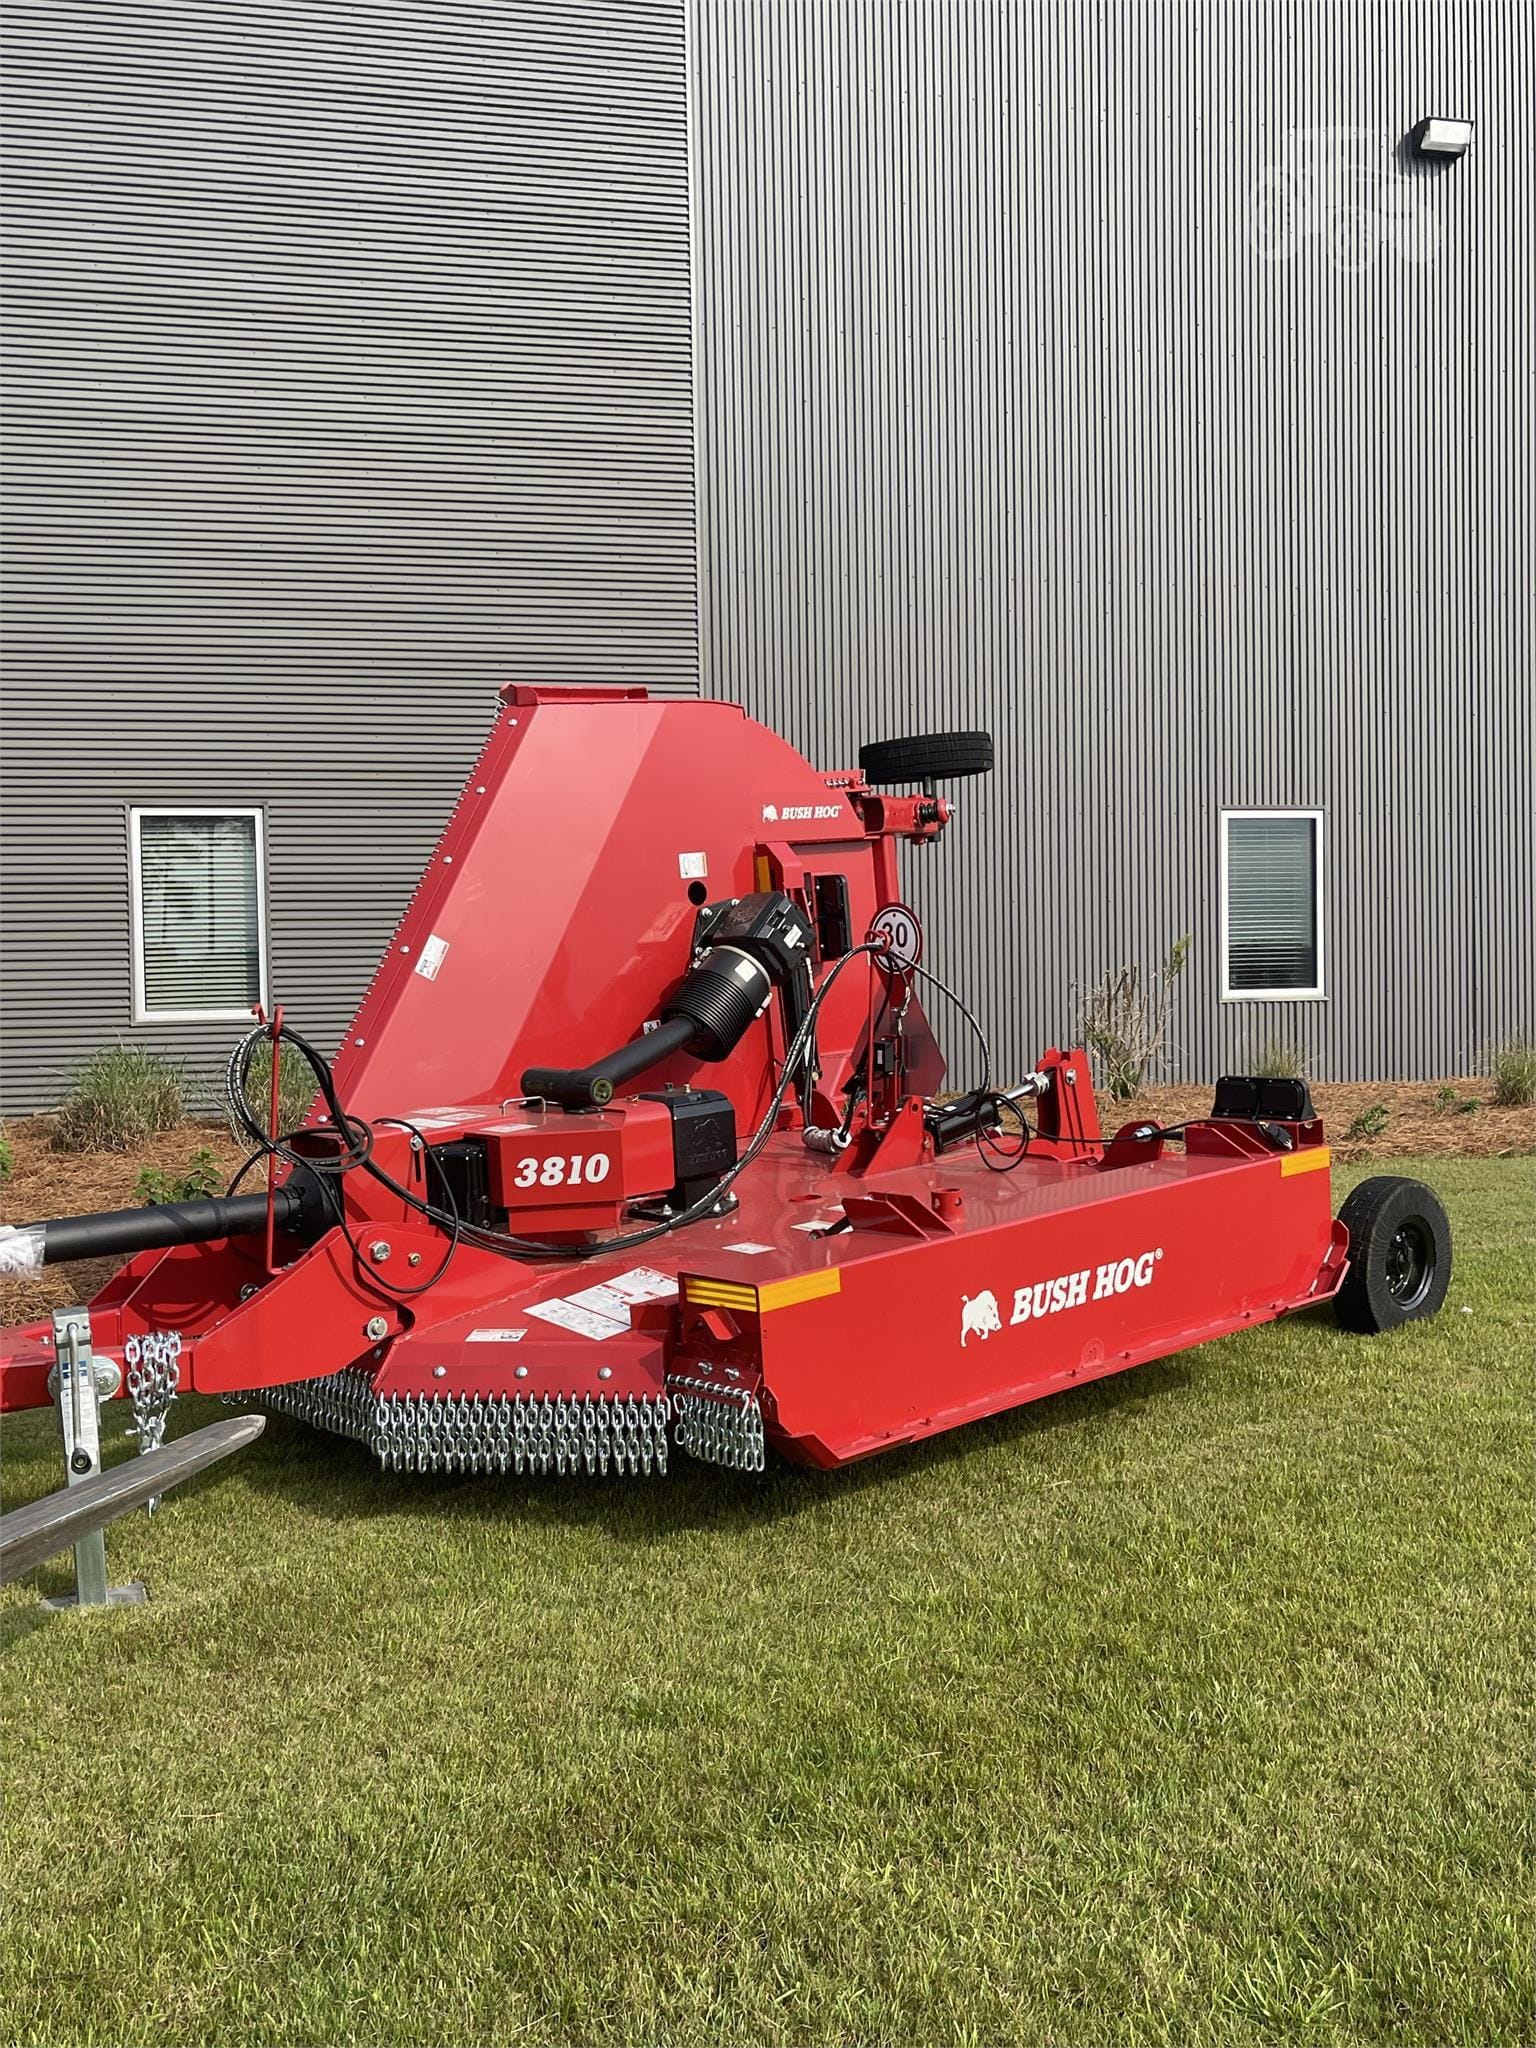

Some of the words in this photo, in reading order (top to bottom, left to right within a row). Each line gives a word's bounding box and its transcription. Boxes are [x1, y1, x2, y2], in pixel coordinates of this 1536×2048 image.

[781, 806, 813, 820] BUSH
[514, 1153, 610, 1188] 3810
[1009, 1269, 1091, 1326] BUSH
